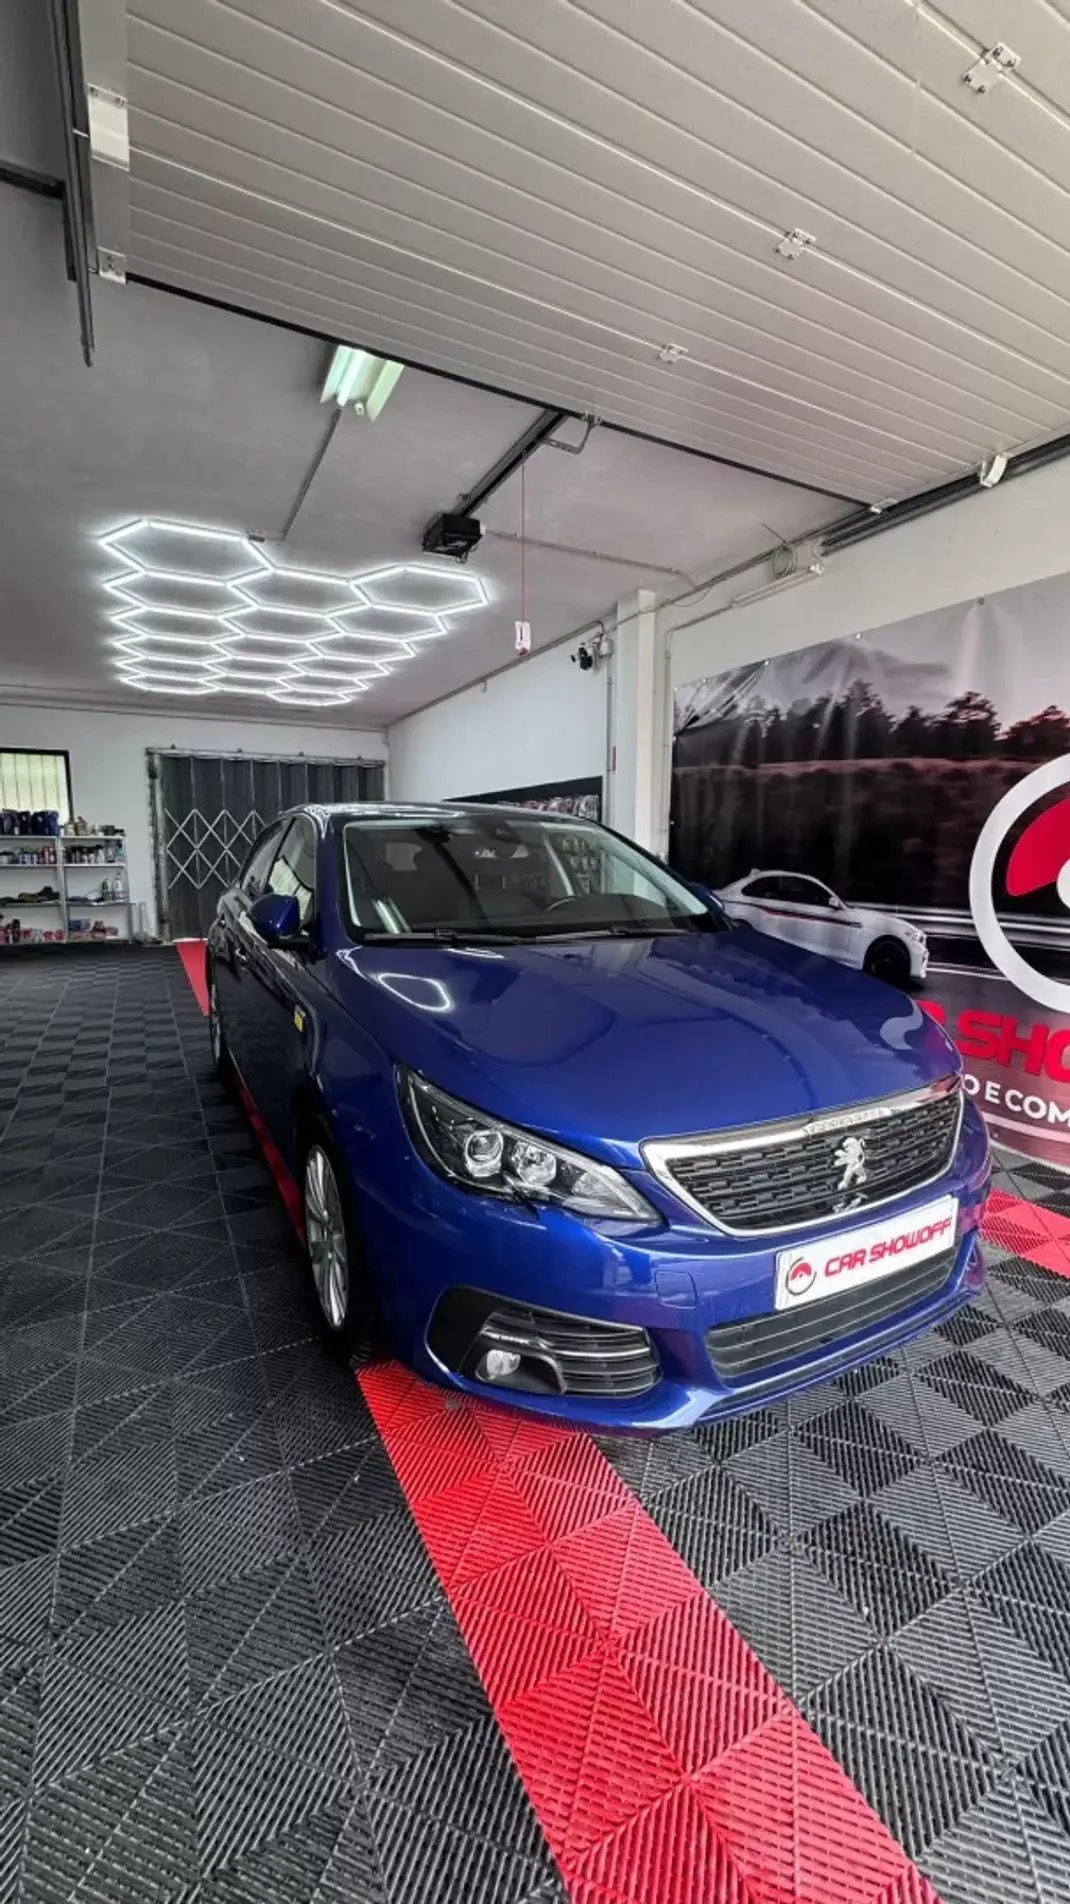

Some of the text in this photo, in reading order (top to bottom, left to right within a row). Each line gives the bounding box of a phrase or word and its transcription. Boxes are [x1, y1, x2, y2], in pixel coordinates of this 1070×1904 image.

[985, 1080, 1001, 1104] E
[825, 1216, 953, 1278] CAR SHOWOFF
